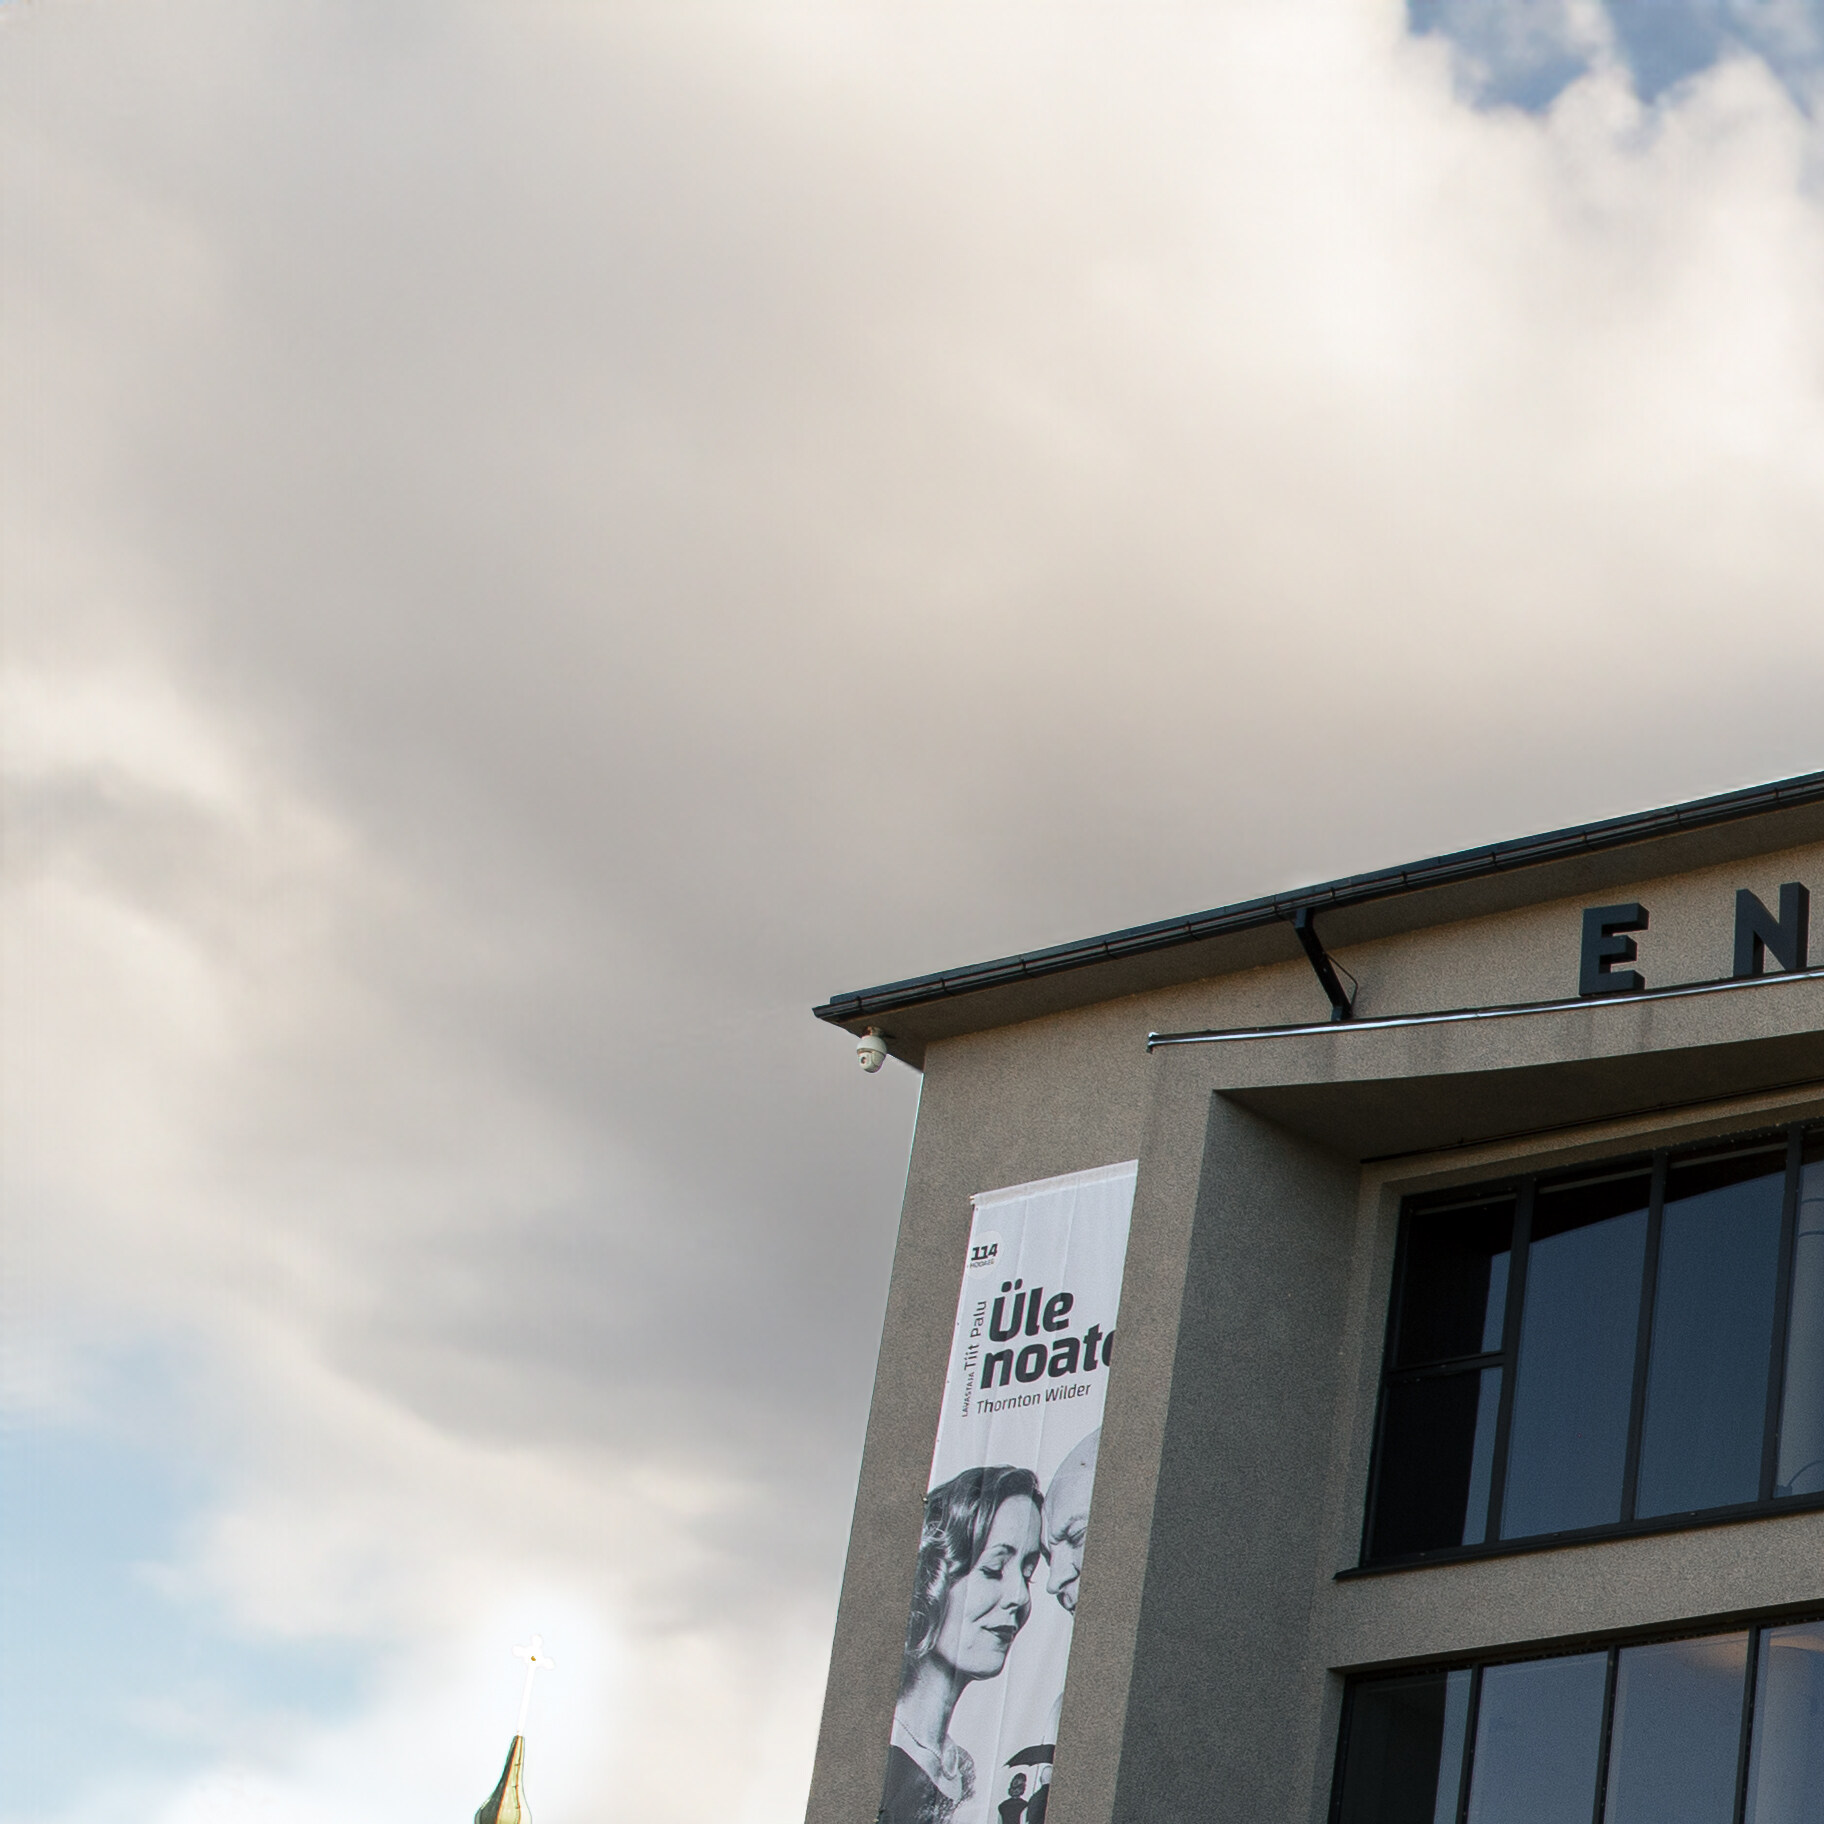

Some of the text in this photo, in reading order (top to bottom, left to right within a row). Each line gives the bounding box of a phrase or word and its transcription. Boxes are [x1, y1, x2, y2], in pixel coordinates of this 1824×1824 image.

[971, 1243, 998, 1261] 114
[970, 1300, 987, 1338] Palu
[989, 1278, 1074, 1342] Üle
[964, 1344, 980, 1371] Tiit
[976, 1384, 1092, 1414] Thornton Wilder
